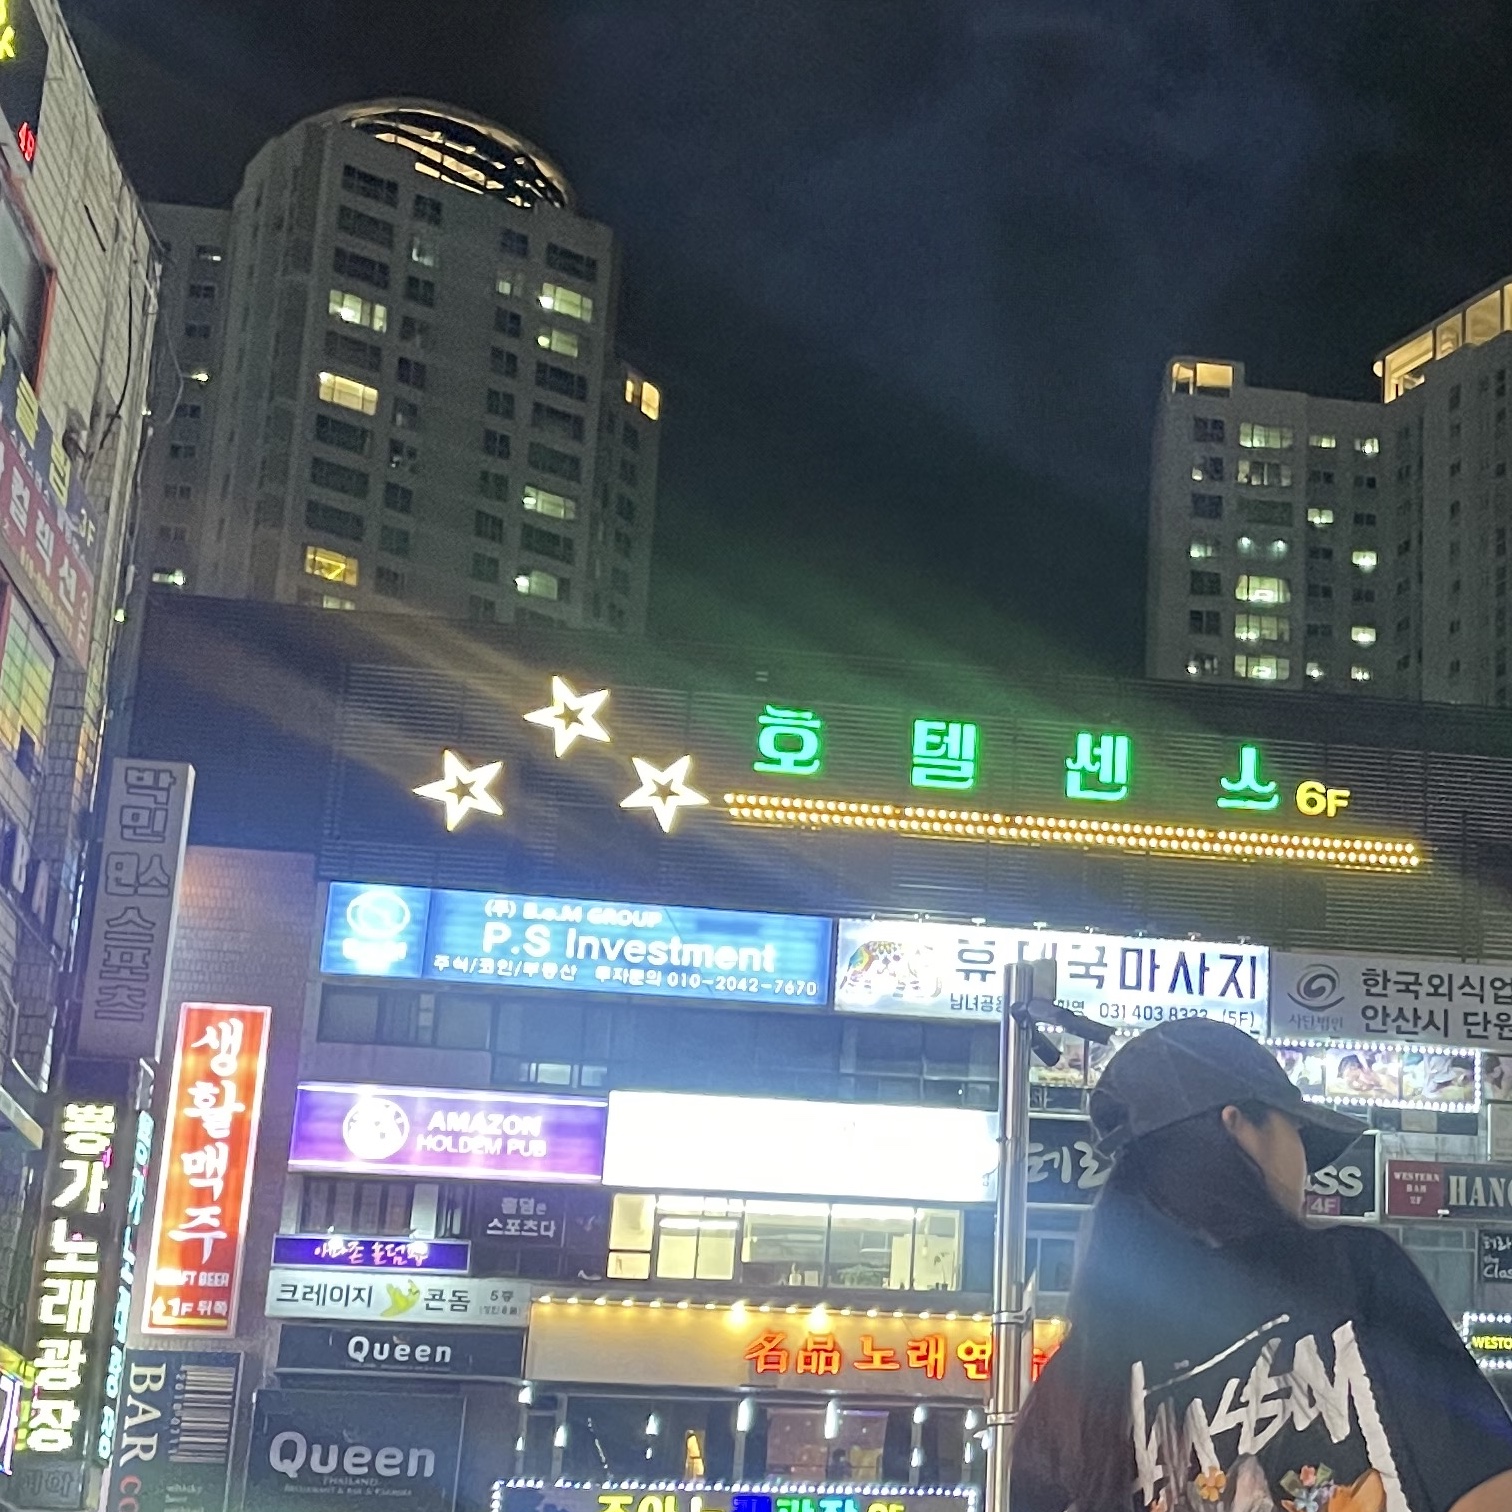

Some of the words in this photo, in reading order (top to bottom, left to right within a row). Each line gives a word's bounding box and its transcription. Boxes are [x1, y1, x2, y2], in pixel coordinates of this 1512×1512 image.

[1294, 780, 1352, 819] 6F
[587, 905, 663, 929] GROUP
[482, 921, 551, 957] P.S
[565, 926, 777, 973] Investment
[94, 906, 157, 1022] 스포츠
[666, 972, 818, 997] 010-2042-7670
[1360, 1003, 1451, 1041] 안산시
[426, 1109, 544, 1138] AMAZON
[166, 1016, 247, 1266] 생활맥주
[416, 1133, 502, 1156] HOLDEM
[506, 1137, 547, 1159] PUB
[1393, 1170, 1441, 1183] WESTERN
[1309, 1198, 1337, 1214] 4F
[485, 1217, 556, 1239] 스포츠다
[276, 1282, 374, 1309] 크레이지
[423, 1287, 472, 1313] 콘돔
[346, 1335, 453, 1364] Queen
[744, 1330, 843, 1376] 名品
[118, 1361, 168, 1469] BAR
[268, 1430, 437, 1479] Queen
